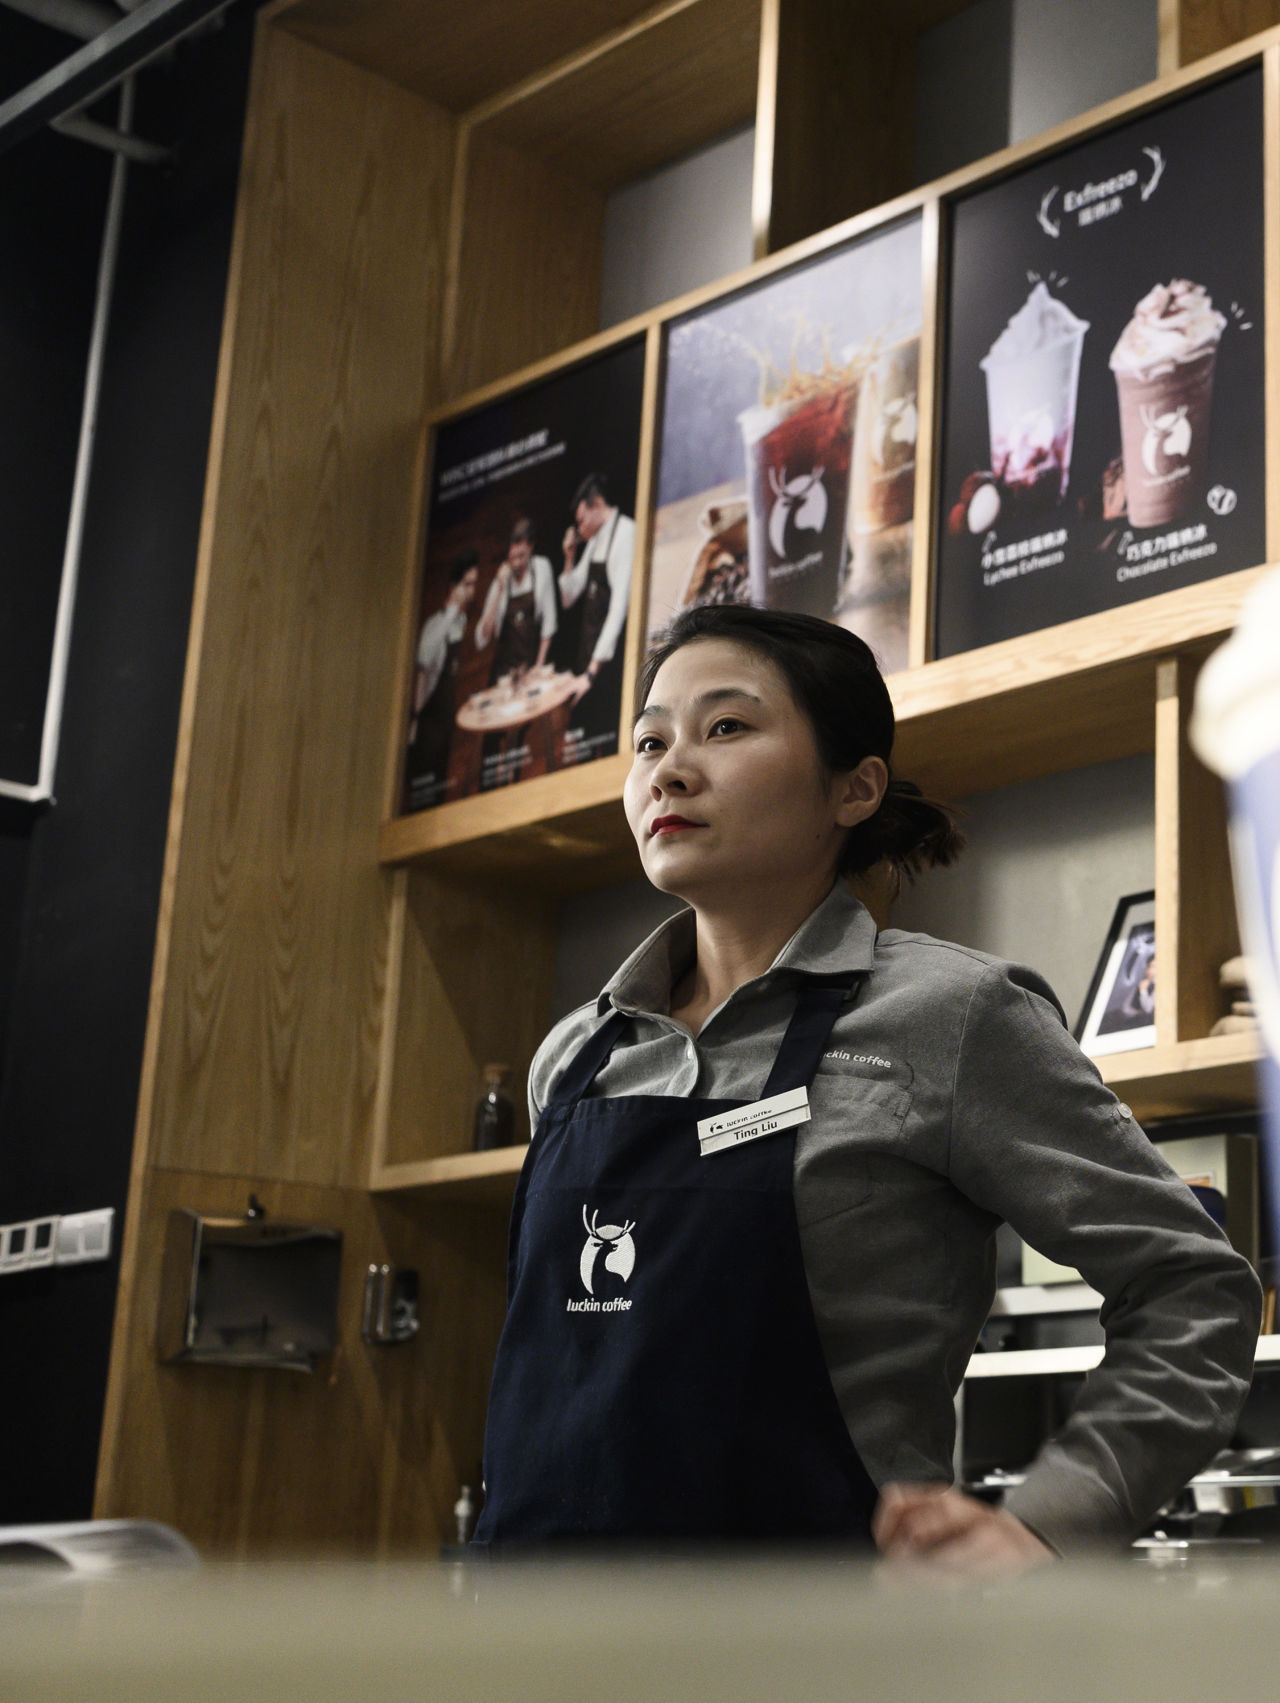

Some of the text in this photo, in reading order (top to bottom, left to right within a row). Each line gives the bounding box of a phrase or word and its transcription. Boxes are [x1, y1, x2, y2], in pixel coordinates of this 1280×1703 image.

[1064, 169, 1138, 212] Exfreezo
[1116, 542, 1217, 582] Chocolate Exfreezo
[853, 1054, 892, 1068] coffee
[734, 1121, 778, 1141] Ting Liu
[566, 1297, 633, 1312] luckin coffee
